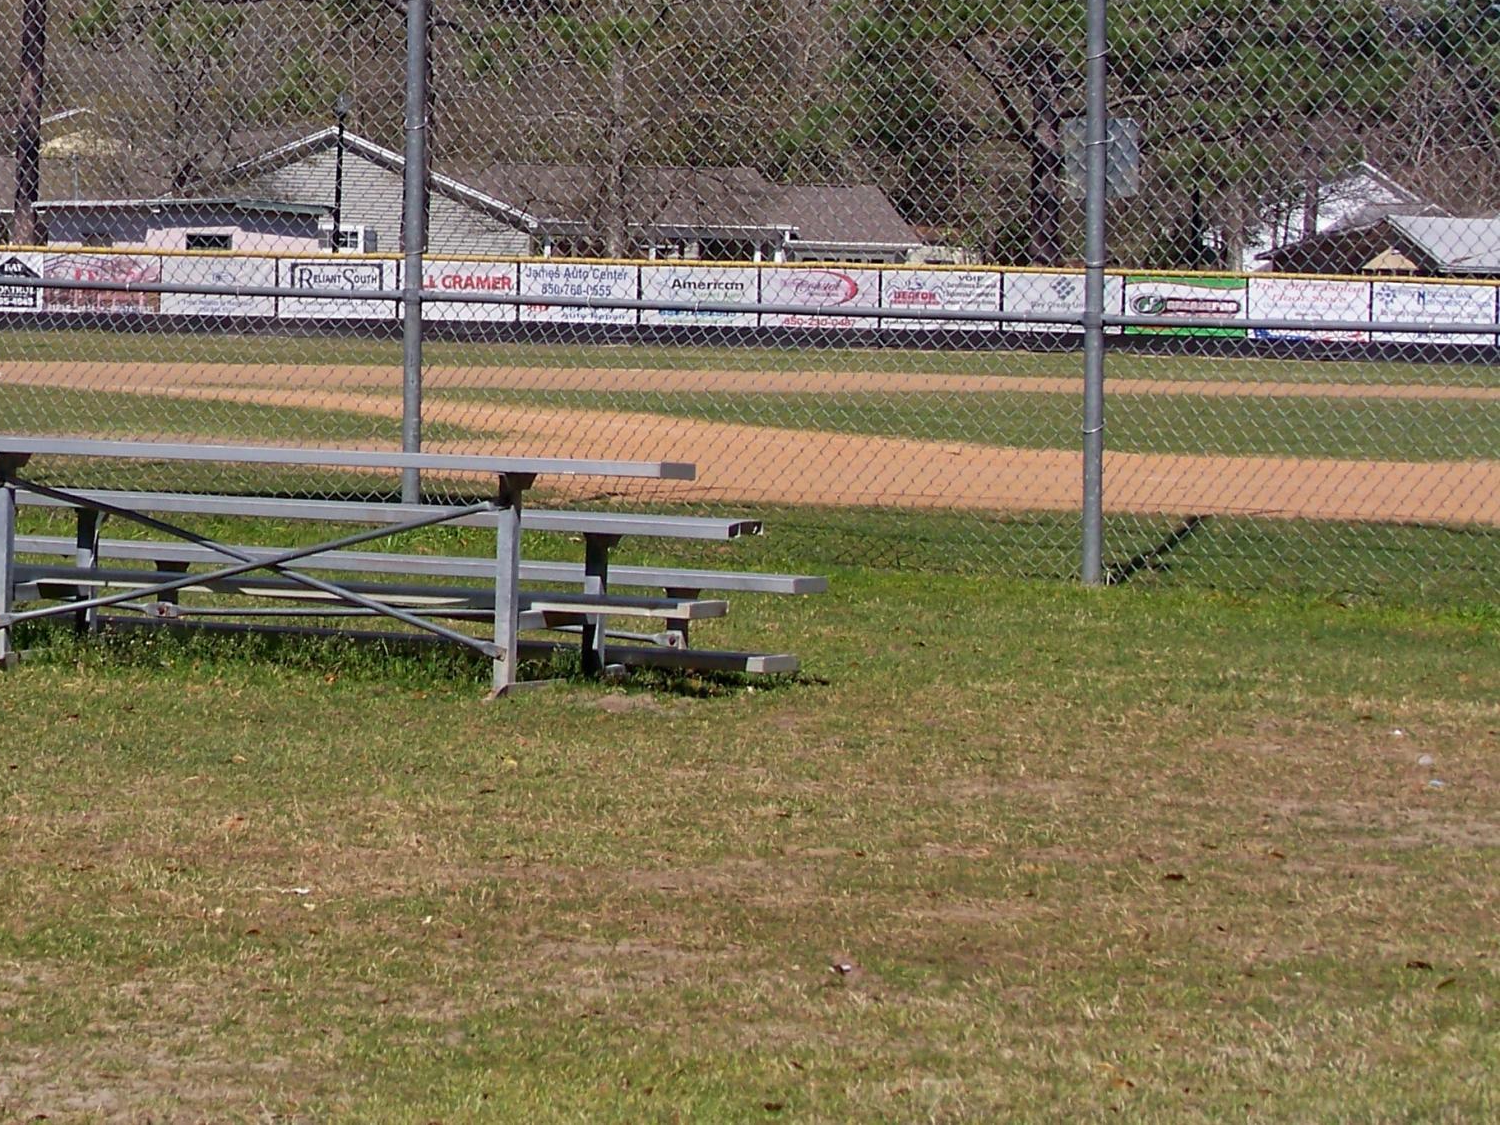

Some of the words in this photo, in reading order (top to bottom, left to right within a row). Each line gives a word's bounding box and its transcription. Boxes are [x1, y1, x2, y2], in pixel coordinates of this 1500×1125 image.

[526, 268, 560, 278] James
[564, 268, 589, 279] Auto
[592, 268, 628, 280] Center
[672, 279, 744, 290] American
